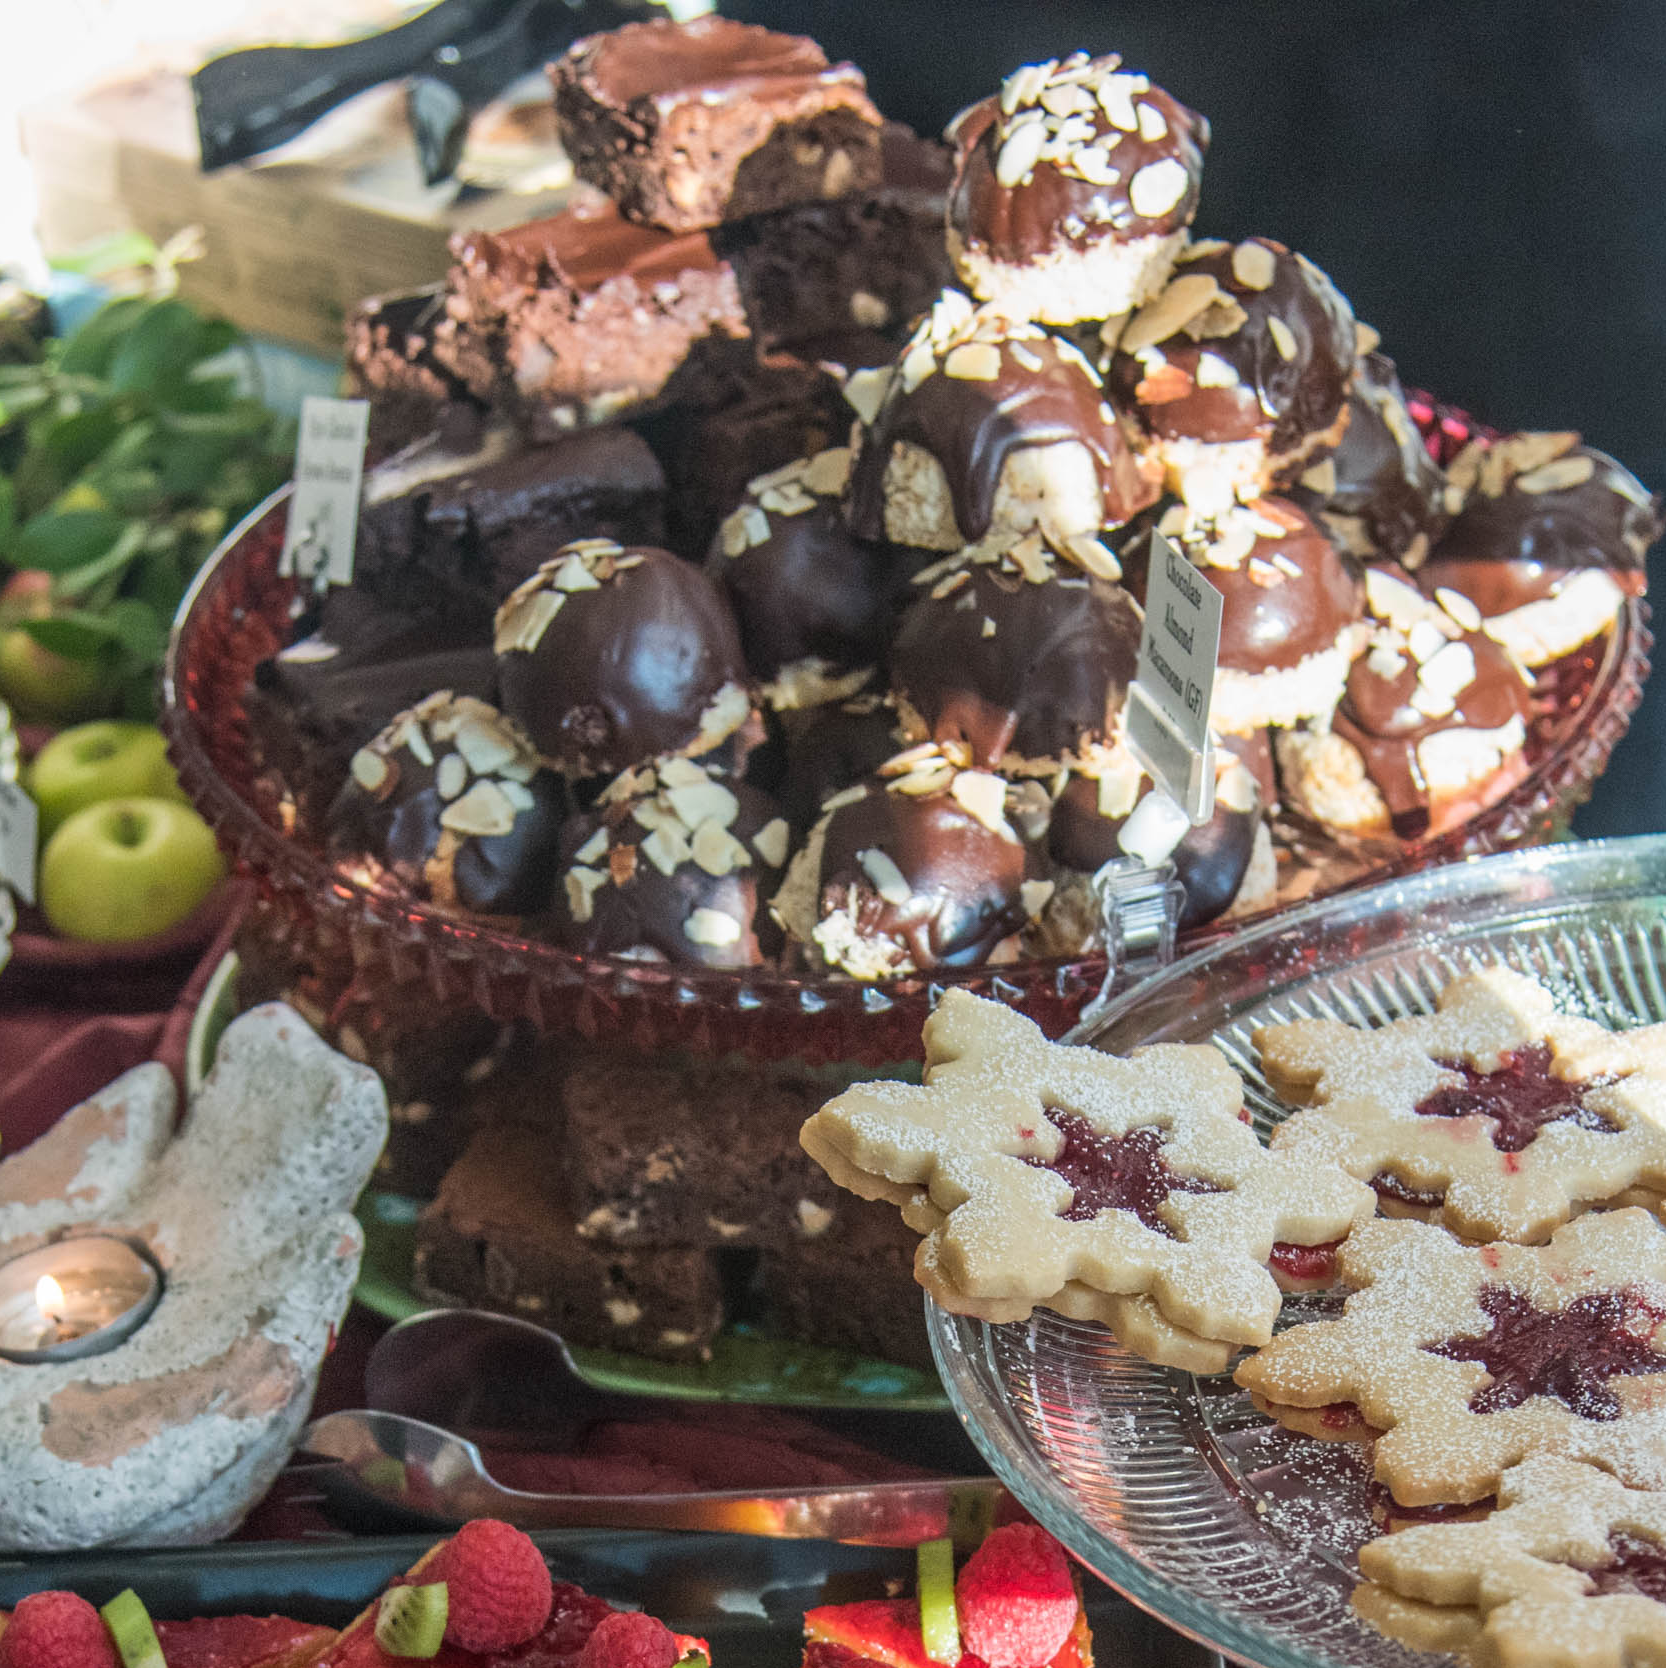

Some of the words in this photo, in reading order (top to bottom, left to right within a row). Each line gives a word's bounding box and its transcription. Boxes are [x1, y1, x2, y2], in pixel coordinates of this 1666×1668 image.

[1166, 553, 1203, 609] Chocolate
[1164, 603, 1193, 656] Almond
[1148, 634, 1183, 698] Macaroons
[1184, 675, 1203, 720] (GF)
